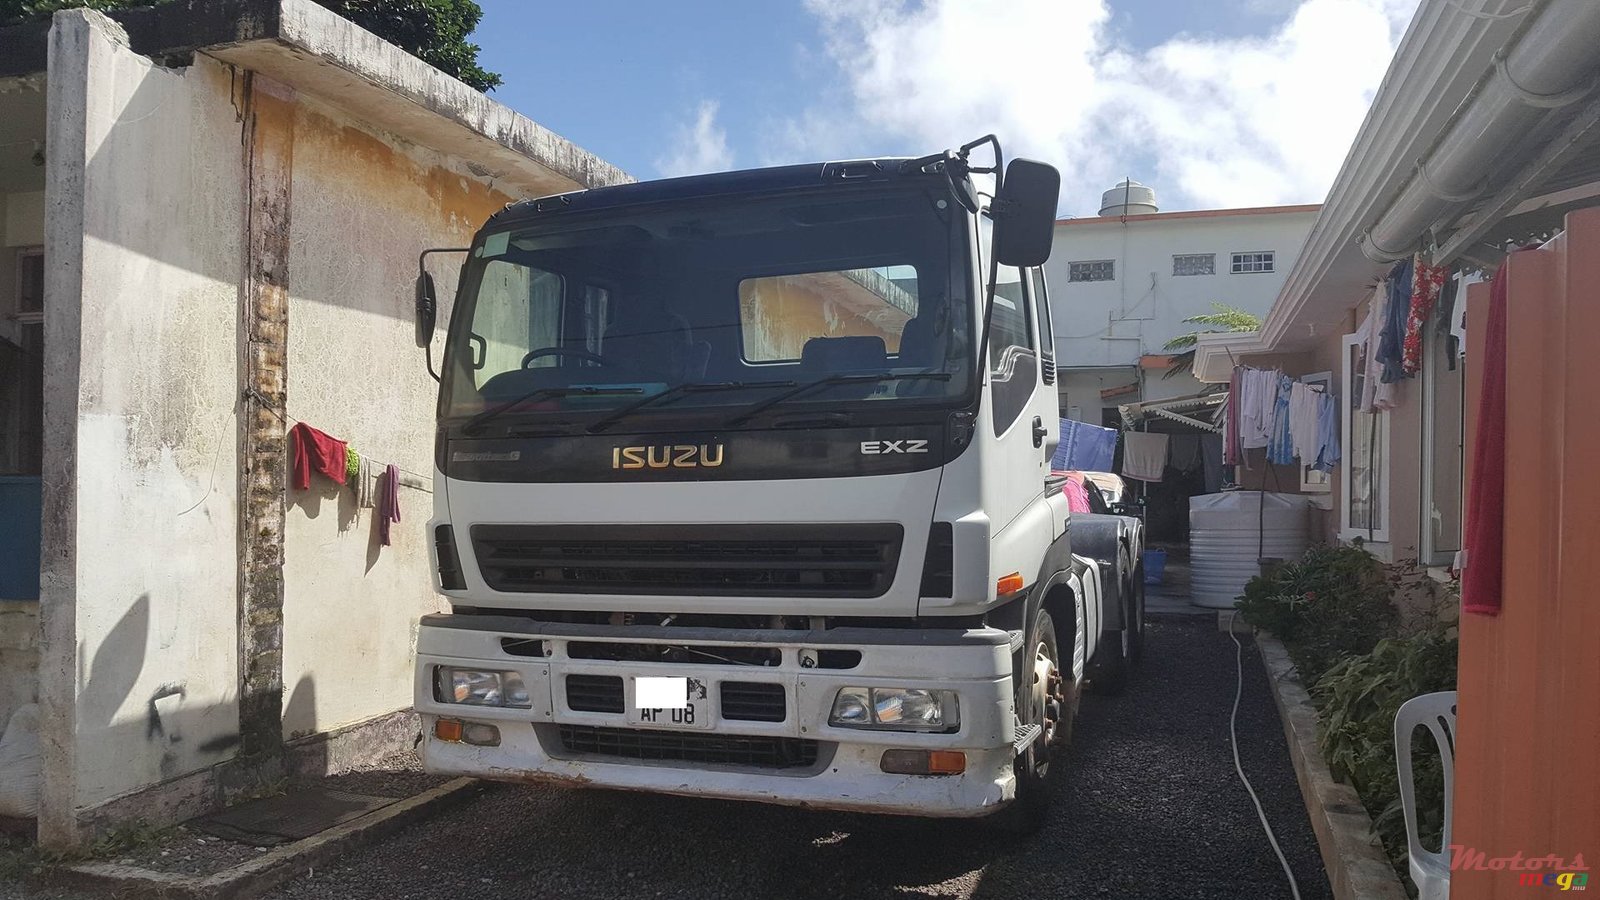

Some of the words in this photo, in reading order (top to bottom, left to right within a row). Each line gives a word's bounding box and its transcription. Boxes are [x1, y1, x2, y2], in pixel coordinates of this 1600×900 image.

[860, 440, 928, 454] EXZ
[612, 444, 724, 469] ISUZU
[640, 707, 663, 722] AP
